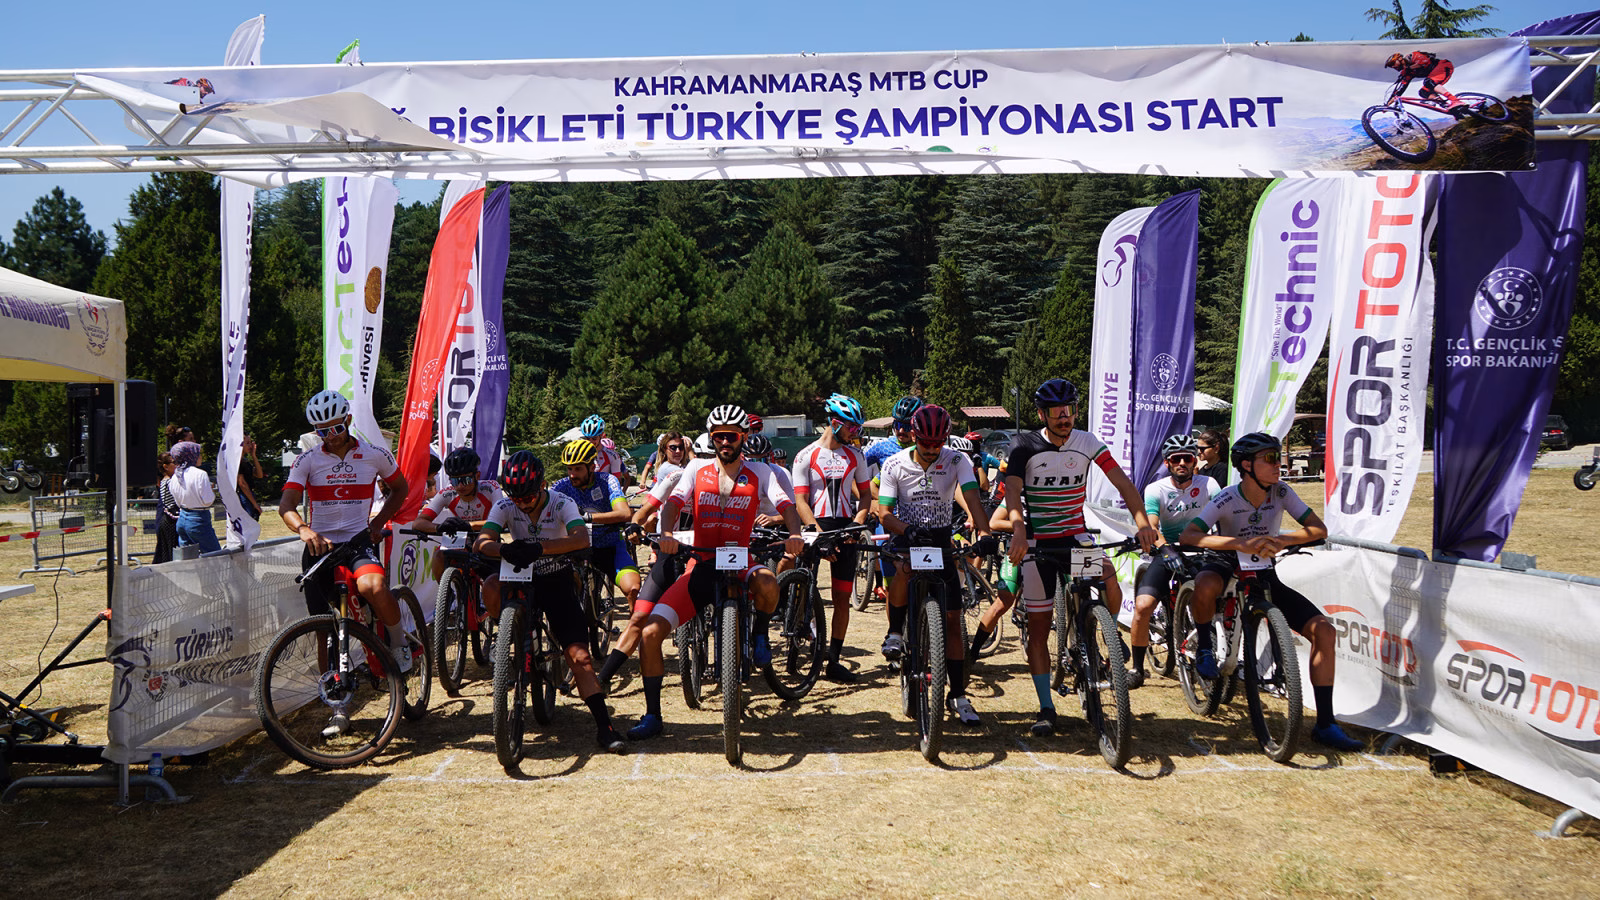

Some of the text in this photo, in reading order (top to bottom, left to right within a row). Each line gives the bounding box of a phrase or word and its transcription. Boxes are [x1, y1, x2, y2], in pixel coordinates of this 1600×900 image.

[614, 69, 988, 97] KAHRAMANMARAŞ MTB CUP
[428, 96, 1283, 145] BİSİKLETİ TÜRKİYE ŞAMPİYONASI START
[1273, 327, 1281, 339] The
[1446, 338, 1470, 350] T.C.
[1473, 336, 1547, 353] GENÇLİK
[1446, 355, 1481, 367] SPOR
[1135, 393, 1149, 401] T.C.
[1098, 371, 1118, 446] TÜRKİYE
[1135, 402, 1154, 411] SPOR
[1386, 336, 1413, 513] EŞKİLAT BAŞKANLIĞI
[1033, 474, 1084, 486] IRAN
[728, 553, 737, 564] 2
[923, 554, 932, 563] 4
[1084, 556, 1092, 568] 5
[1251, 553, 1260, 562] 6
[175, 624, 233, 663] TÜRKİYE
